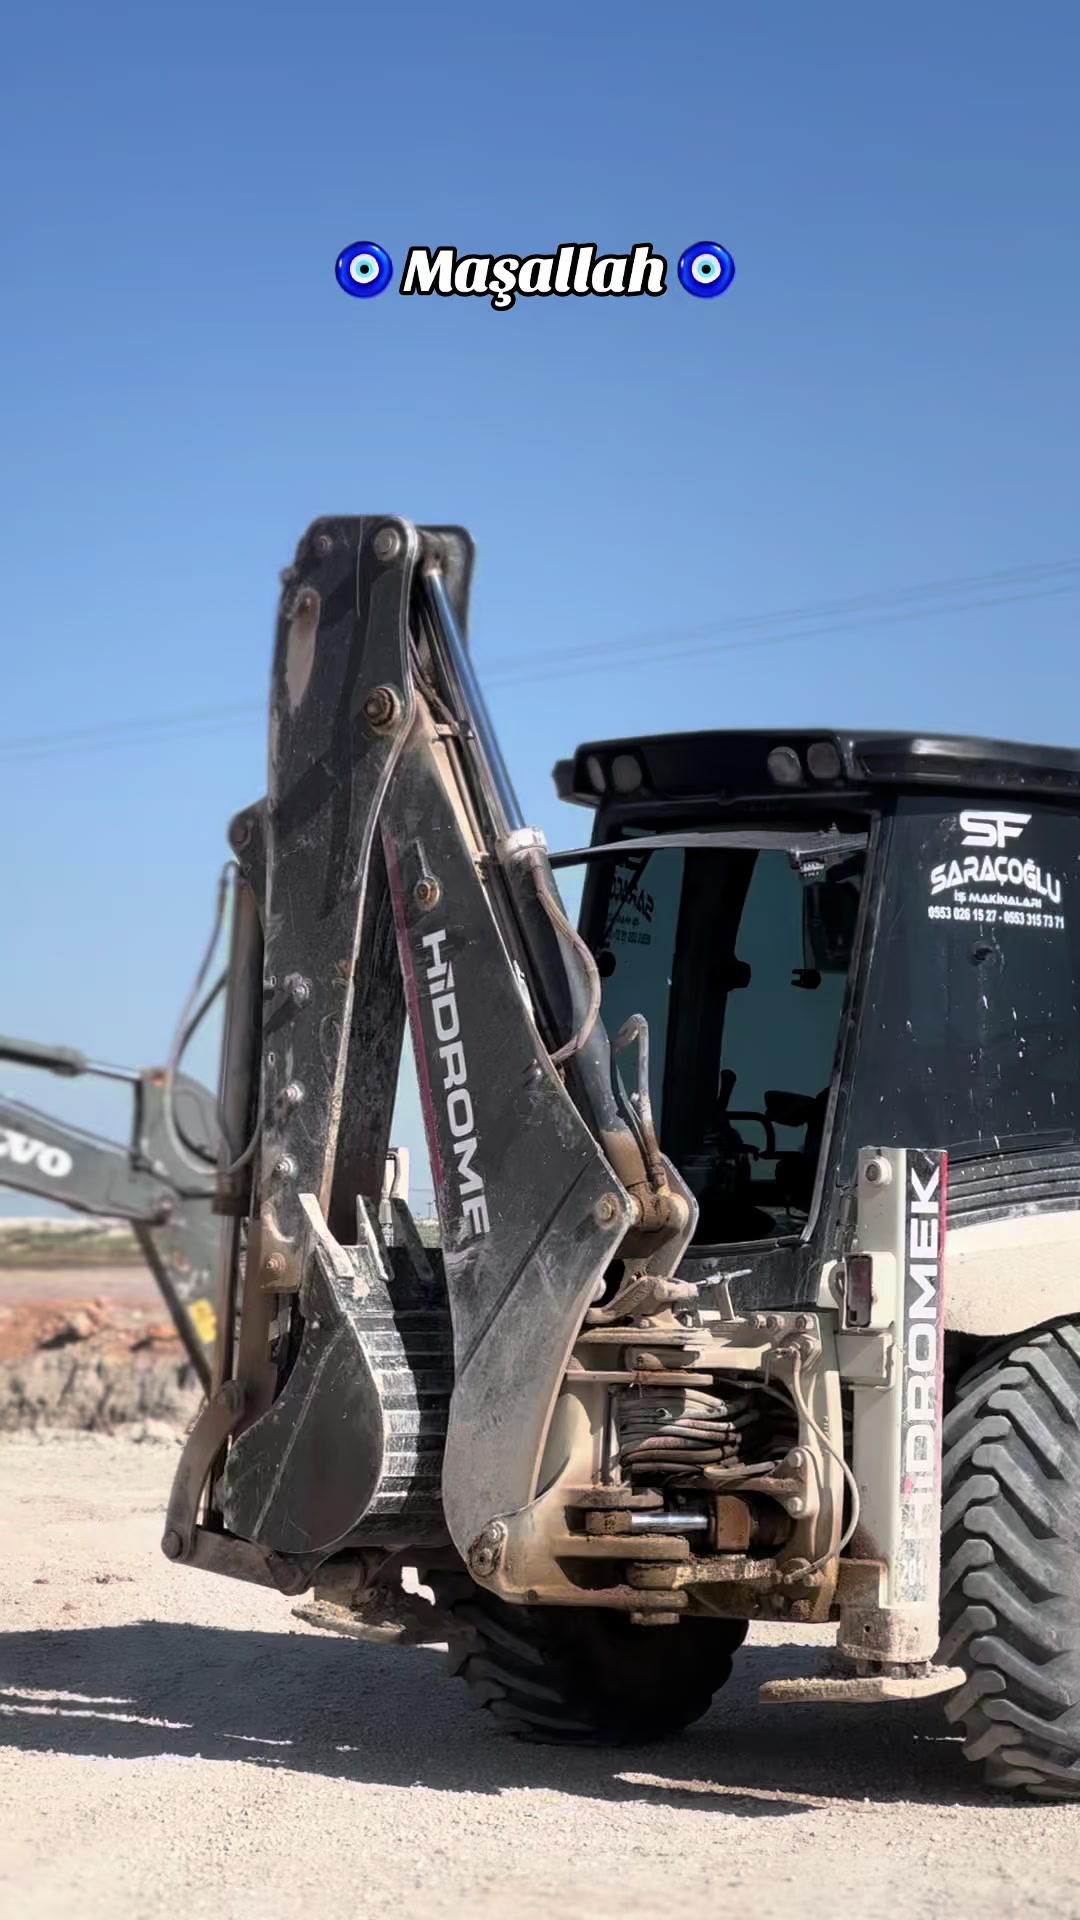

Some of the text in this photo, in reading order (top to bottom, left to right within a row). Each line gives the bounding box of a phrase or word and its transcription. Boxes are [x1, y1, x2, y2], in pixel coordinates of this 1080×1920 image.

[959, 810, 1032, 848] SF
[930, 855, 1061, 904] SARAÇOĞLU
[928, 906, 951, 919] 0553
[953, 907, 970, 921] 026
[973, 908, 984, 921] 15
[985, 909, 997, 922] 27
[1003, 911, 1024, 925] 0553
[1026, 913, 1041, 927] 315
[1043, 914, 1053, 928] 73
[1055, 916, 1064, 929] 71
[0, 1128, 73, 1177] VO
